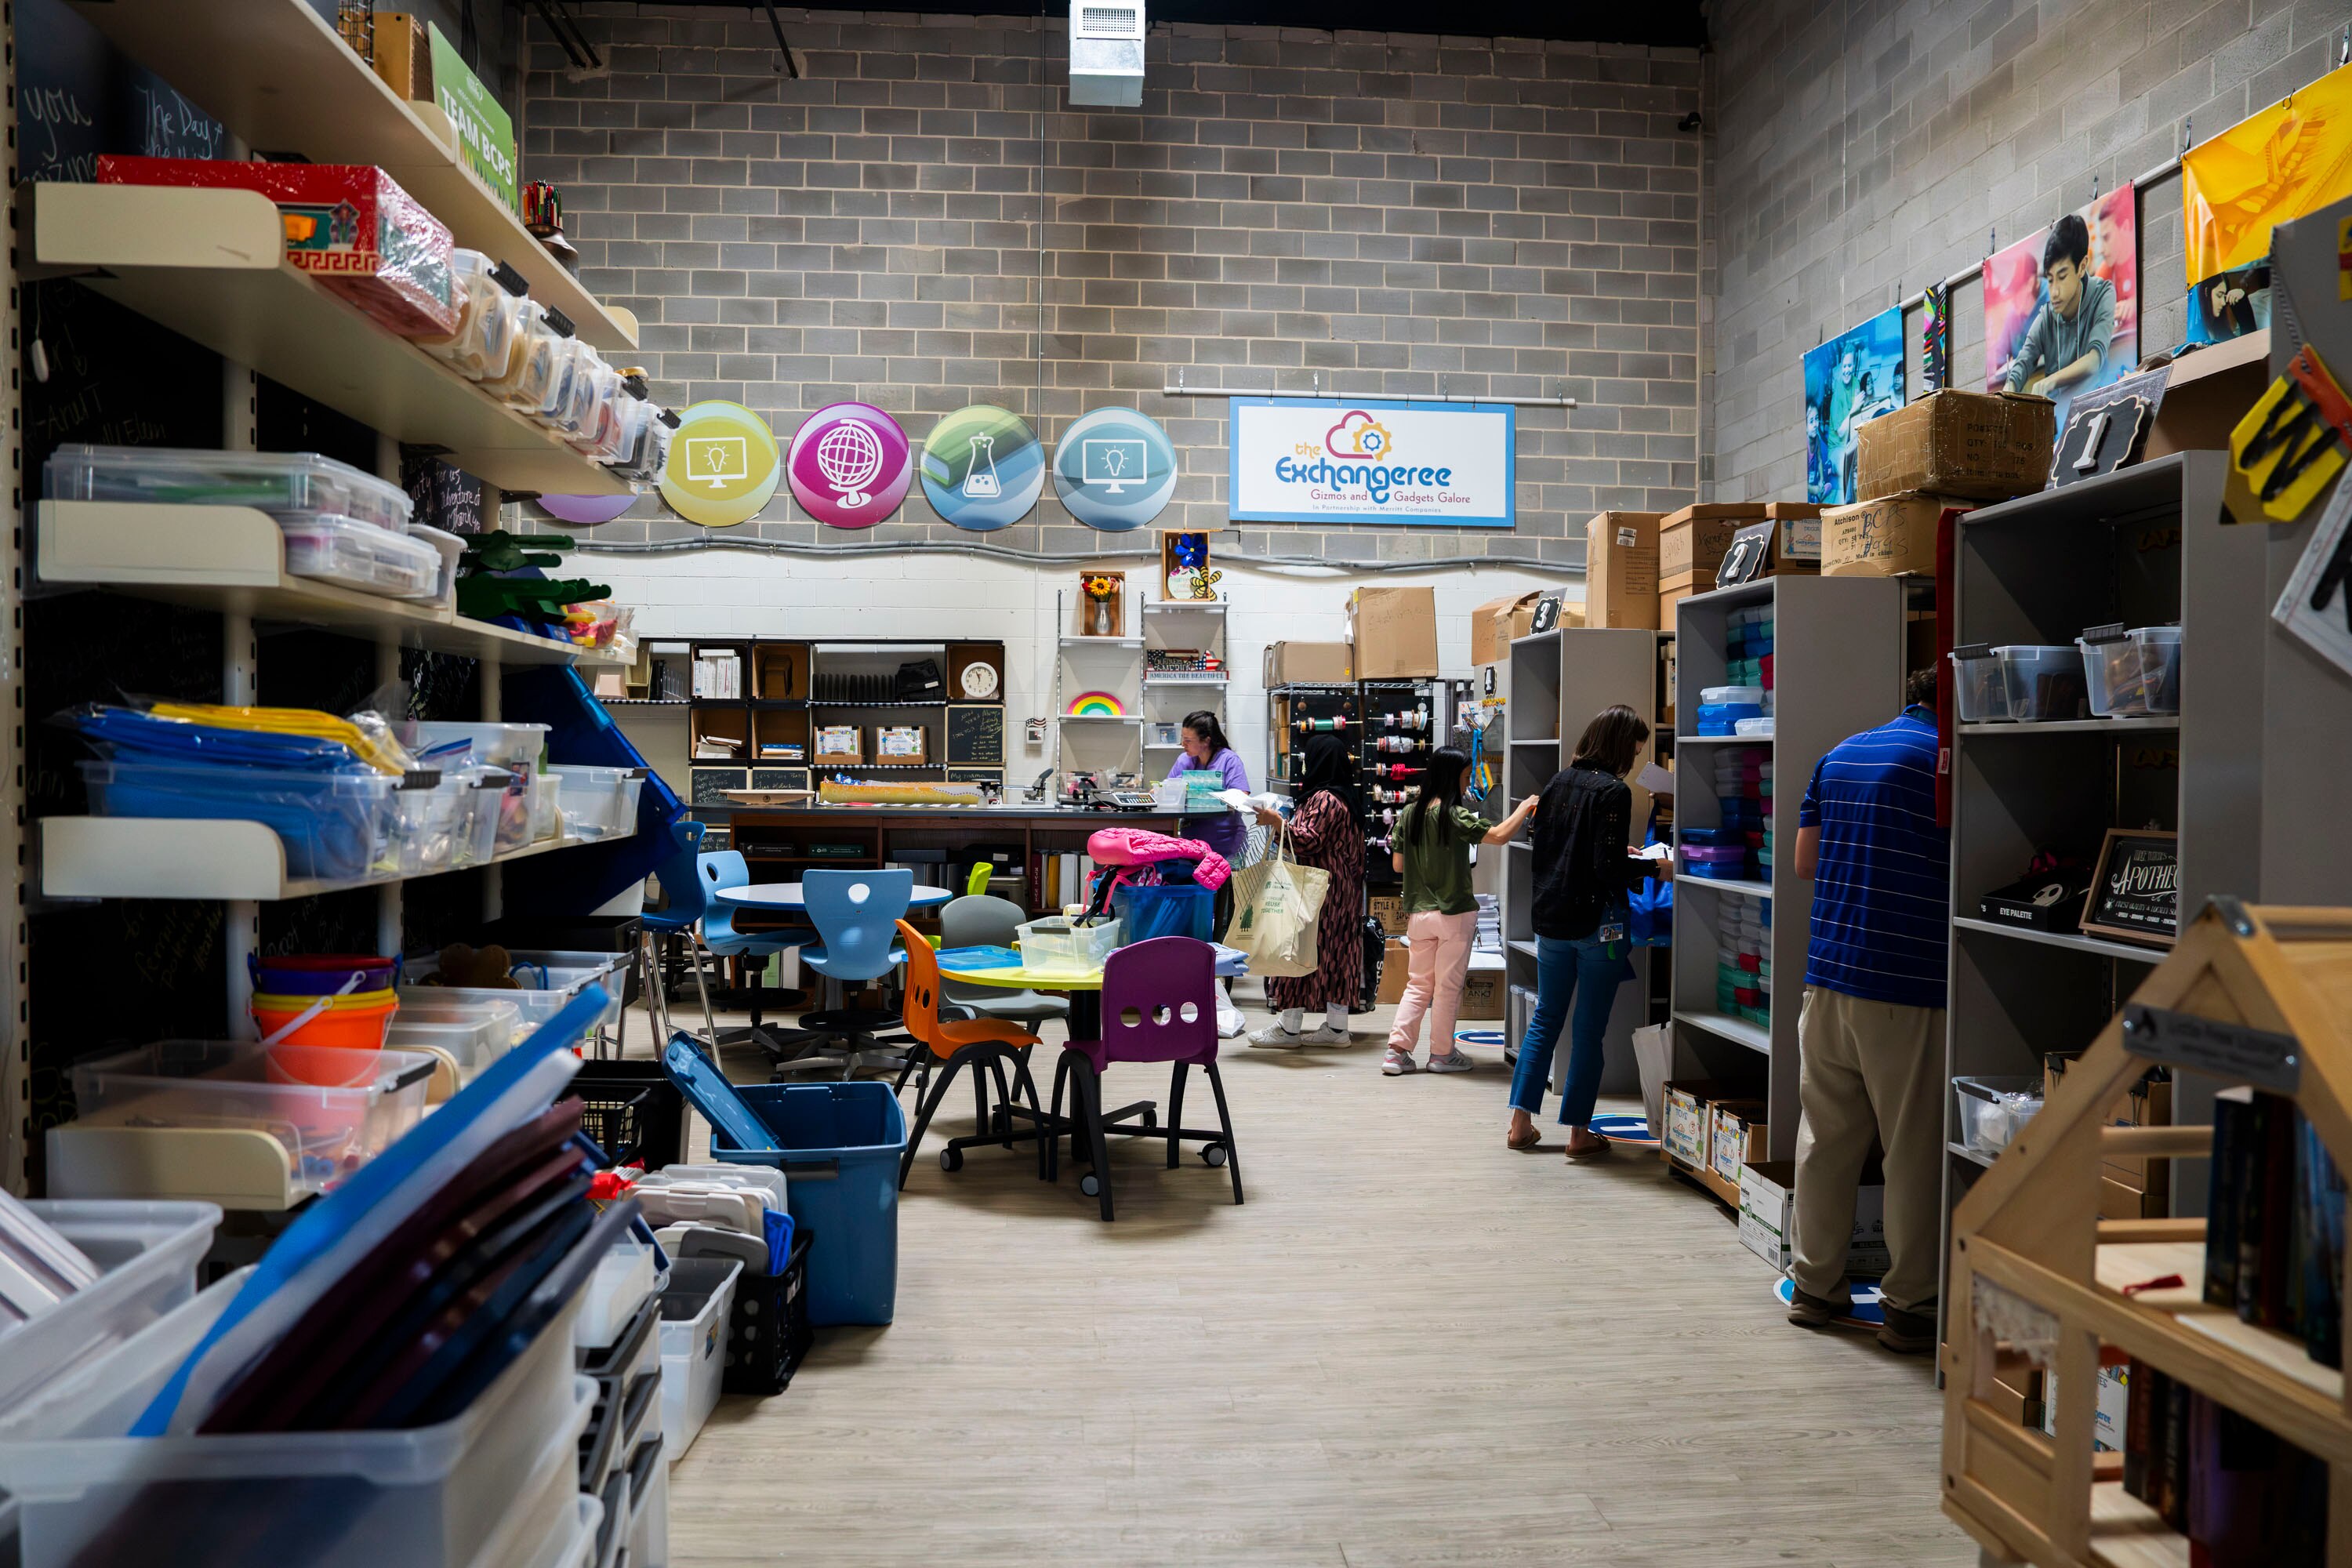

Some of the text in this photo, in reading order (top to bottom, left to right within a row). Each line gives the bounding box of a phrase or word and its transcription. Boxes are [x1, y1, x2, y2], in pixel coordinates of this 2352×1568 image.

[24, 87, 92, 162] you
[441, 85, 480, 151] TEAM
[481, 132, 512, 186] BCPS
[1295, 442, 1321, 459] the
[2072, 412, 2110, 469] 1
[2240, 379, 2341, 503] W
[449, 468, 461, 485] us
[1276, 456, 1452, 504] Exchangeree
[1311, 489, 1471, 504] Gizmos and Gadgets Galore
[1835, 514, 1860, 526] Atchison
[1863, 503, 1907, 539] BCPS
[1724, 543, 1749, 579] 2
[1536, 602, 1551, 628] 3
[1374, 901, 1389, 910] STYLE
[2000, 907, 2032, 920] EYE PALETTE
